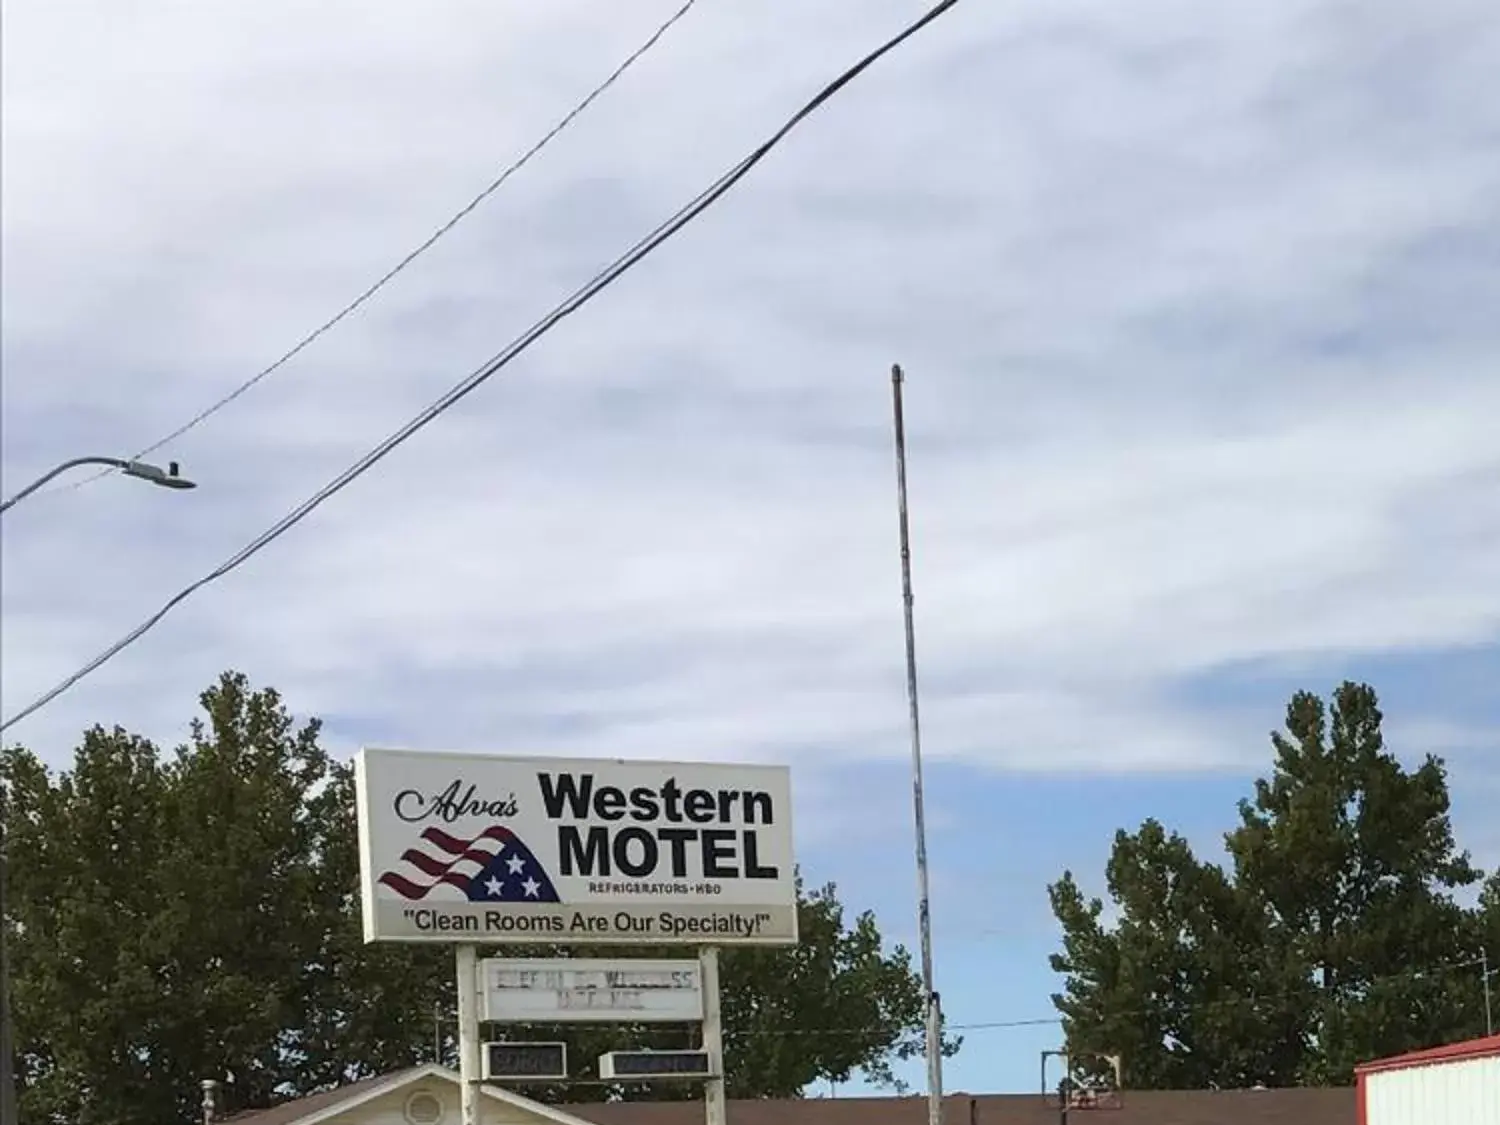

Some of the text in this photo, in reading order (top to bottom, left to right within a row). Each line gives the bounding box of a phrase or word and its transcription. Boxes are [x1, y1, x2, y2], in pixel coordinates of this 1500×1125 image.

[394, 778, 518, 822] Alva's
[537, 773, 774, 825] Western
[558, 825, 779, 880] MOTEL
[404, 909, 771, 938] "Clean Rooms Are Our Specialty!"
